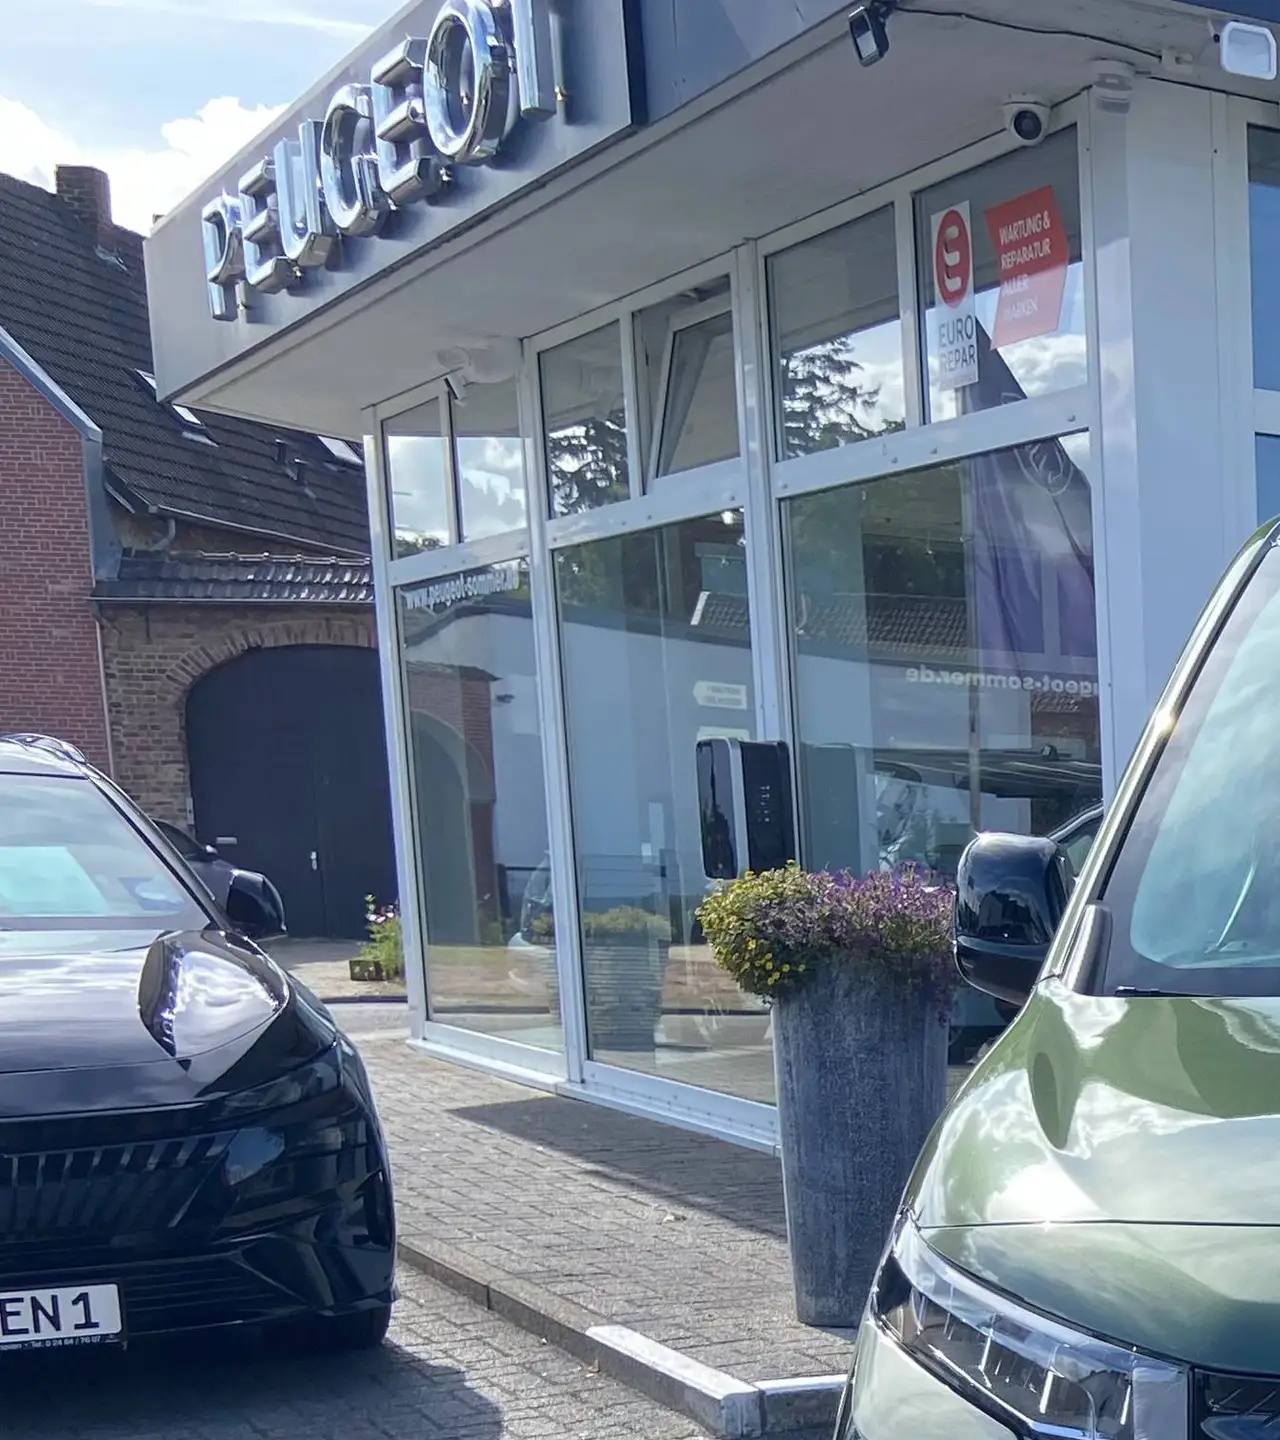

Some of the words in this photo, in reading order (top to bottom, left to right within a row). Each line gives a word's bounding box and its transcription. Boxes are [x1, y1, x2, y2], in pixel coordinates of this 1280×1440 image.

[999, 213, 1042, 246] WARTUNG
[1042, 210, 1051, 230] &
[1001, 238, 1051, 270] REPARATUR
[938, 314, 974, 348] EURO
[71, 1291, 100, 1331] 1
